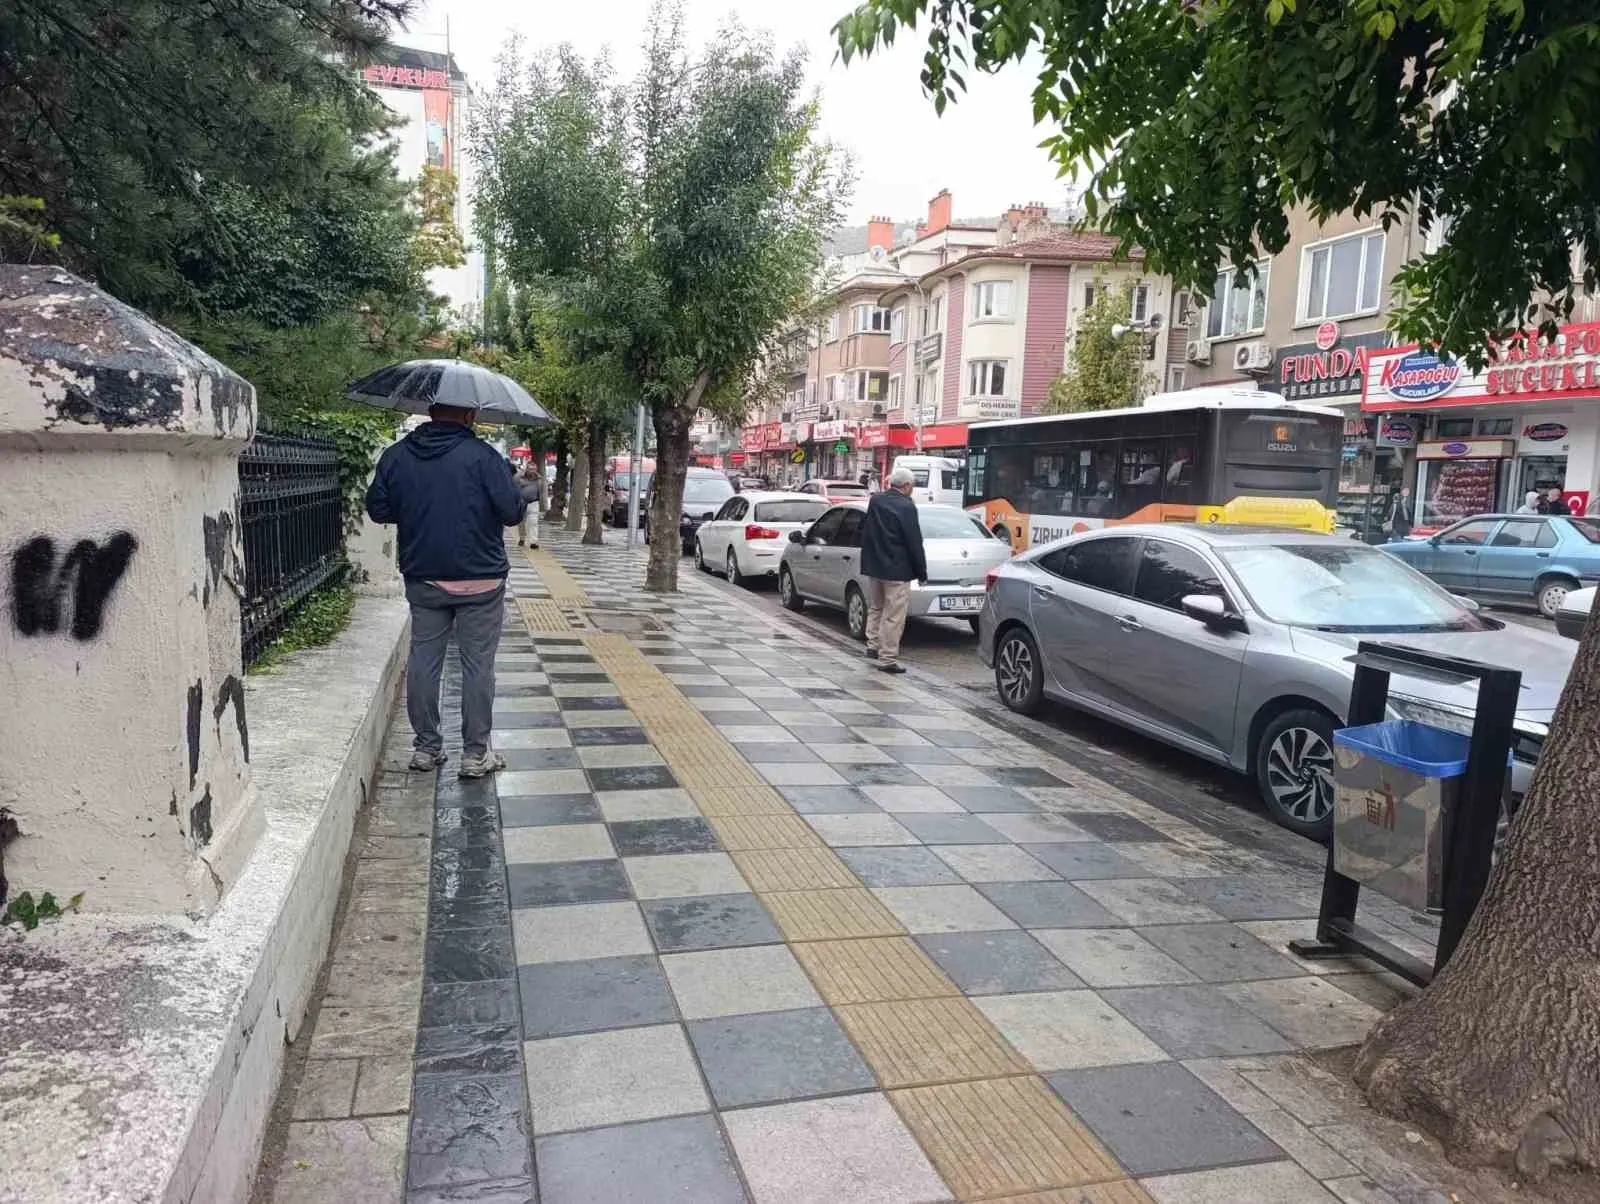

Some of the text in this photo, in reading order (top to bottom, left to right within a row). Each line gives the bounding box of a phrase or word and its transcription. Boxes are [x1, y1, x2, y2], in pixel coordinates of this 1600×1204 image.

[1281, 346, 1367, 384] FUNDA
[1380, 359, 1460, 388] KASAPOĞLU
[1267, 442, 1297, 452] ISUZU
